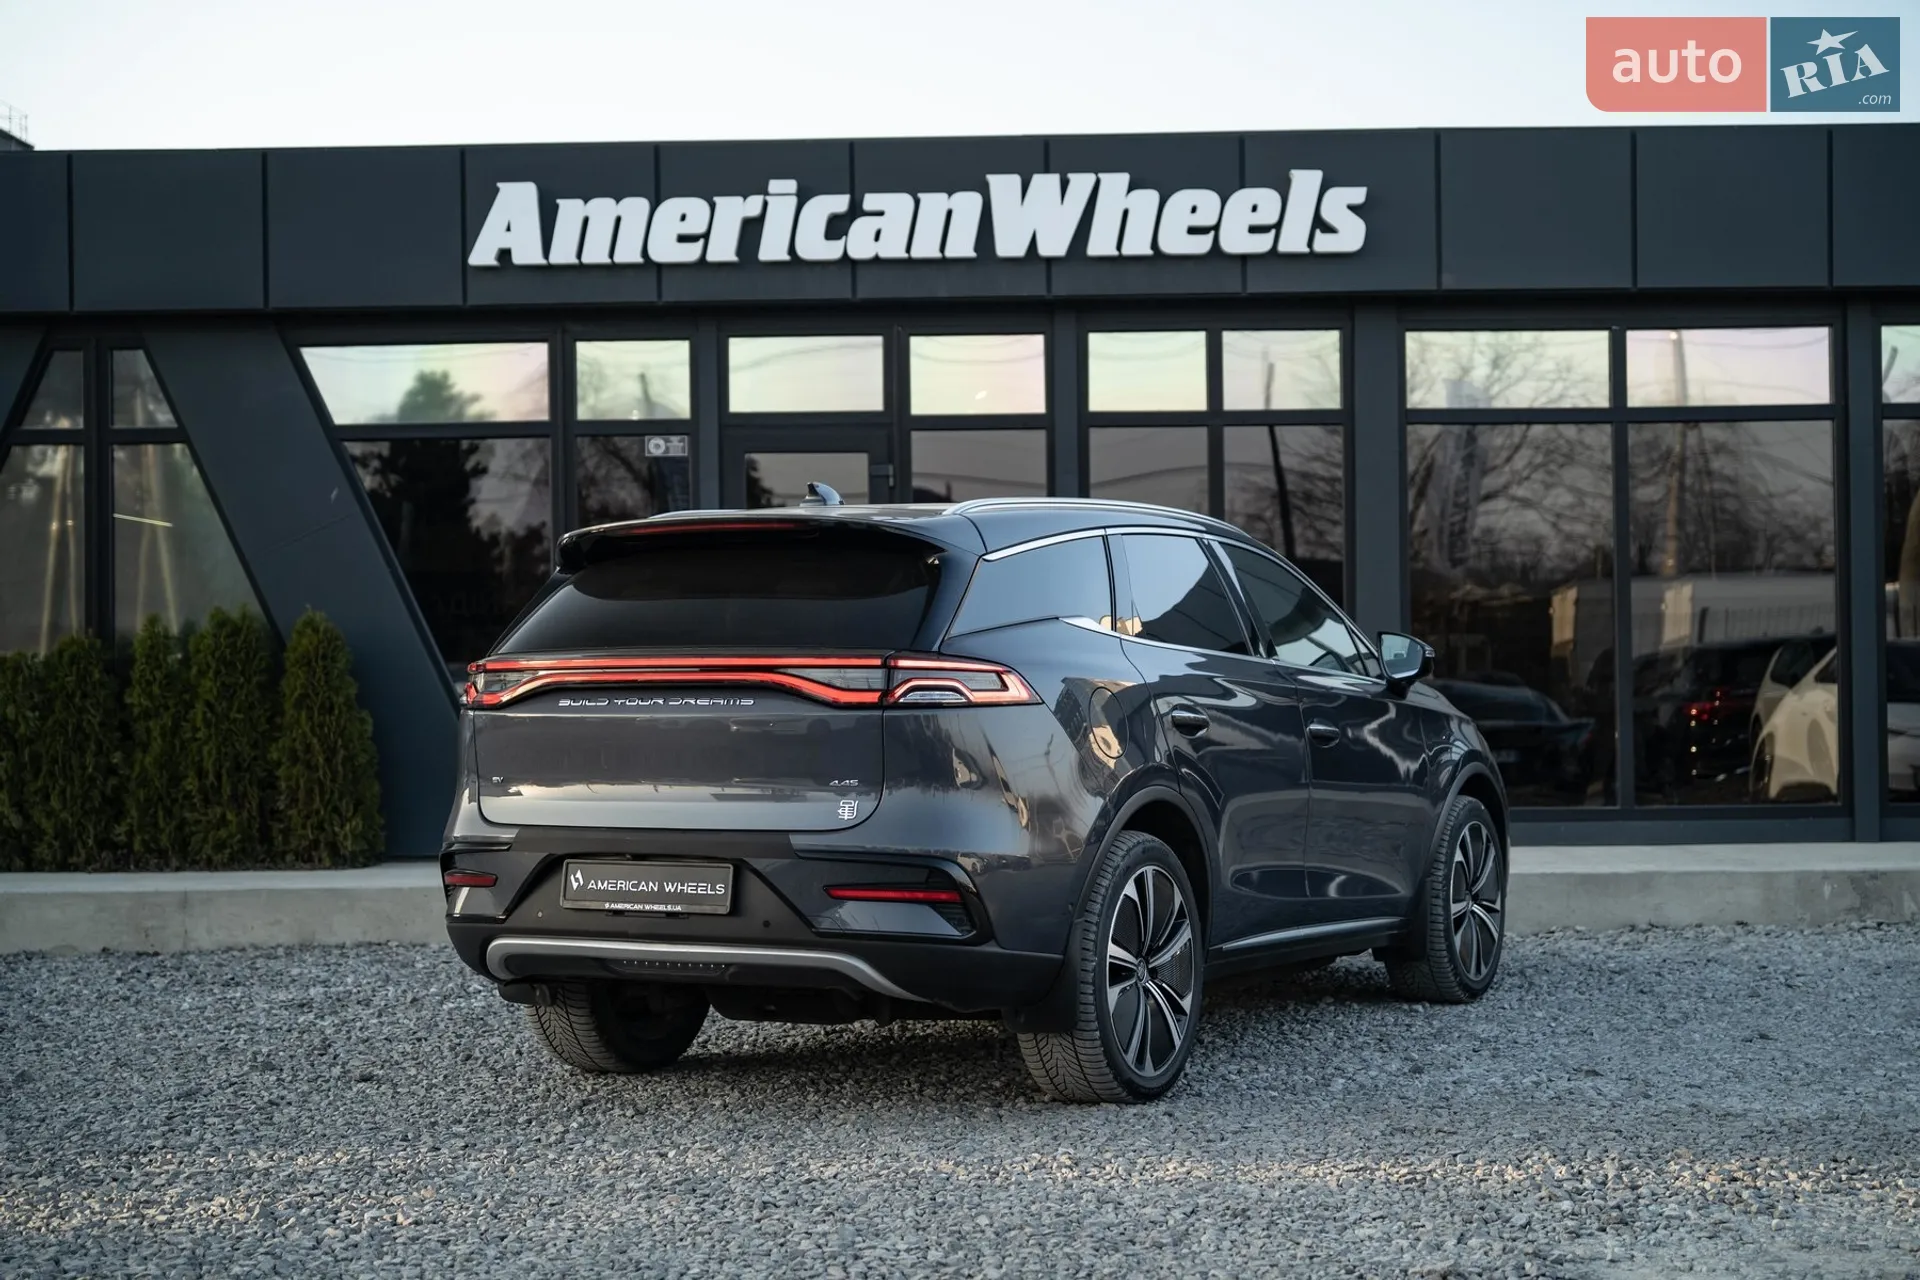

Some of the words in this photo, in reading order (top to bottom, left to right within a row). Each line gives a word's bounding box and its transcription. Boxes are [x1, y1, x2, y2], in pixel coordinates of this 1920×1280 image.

[467, 168, 1369, 267] AmericanWheels
[558, 697, 610, 706] BUILD
[614, 697, 665, 706] YOUR
[668, 697, 755, 706] DREAMS
[586, 879, 659, 892] AMERICAN
[663, 881, 726, 895] WHEELS
[644, 903, 682, 911] WHEELS.UA
